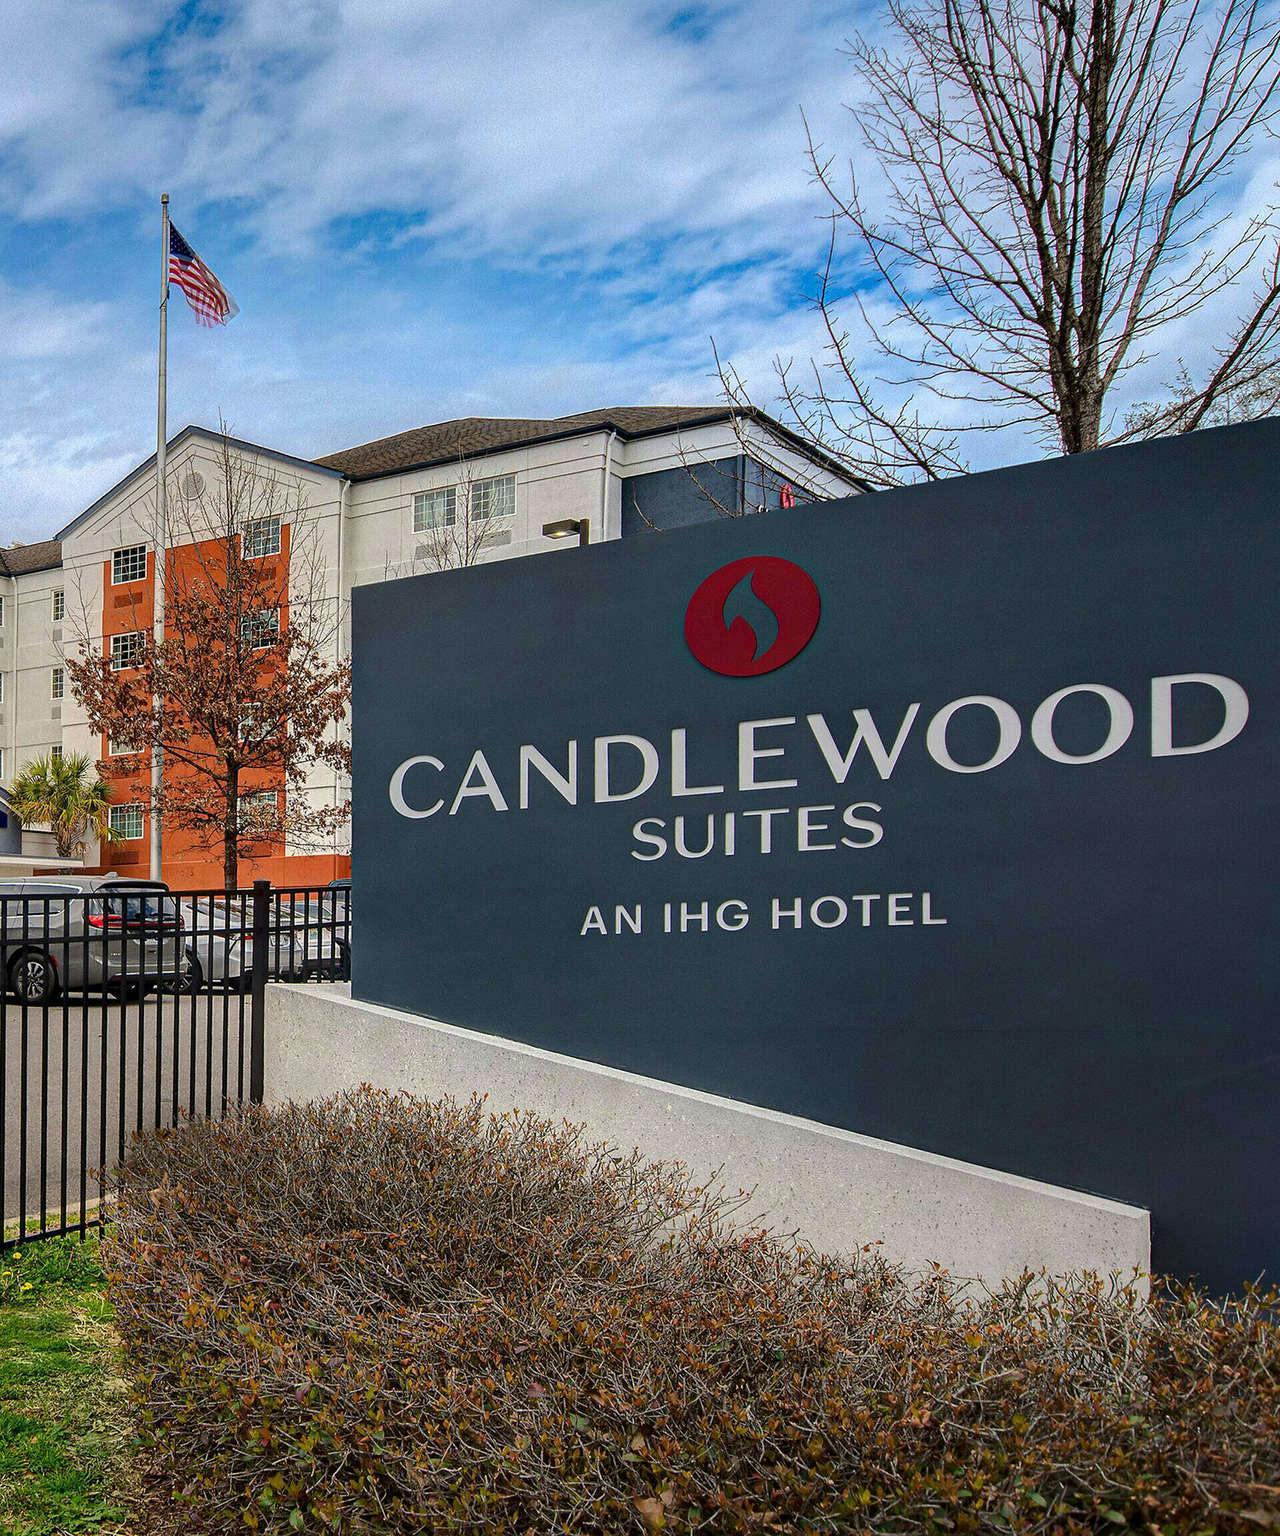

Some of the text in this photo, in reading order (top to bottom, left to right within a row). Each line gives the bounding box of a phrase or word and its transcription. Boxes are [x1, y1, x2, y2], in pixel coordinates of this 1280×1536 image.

[389, 673, 1249, 819] CANDLEWOOD
[631, 802, 884, 861] SUITES
[580, 892, 949, 936] AN IHG HOTEL
